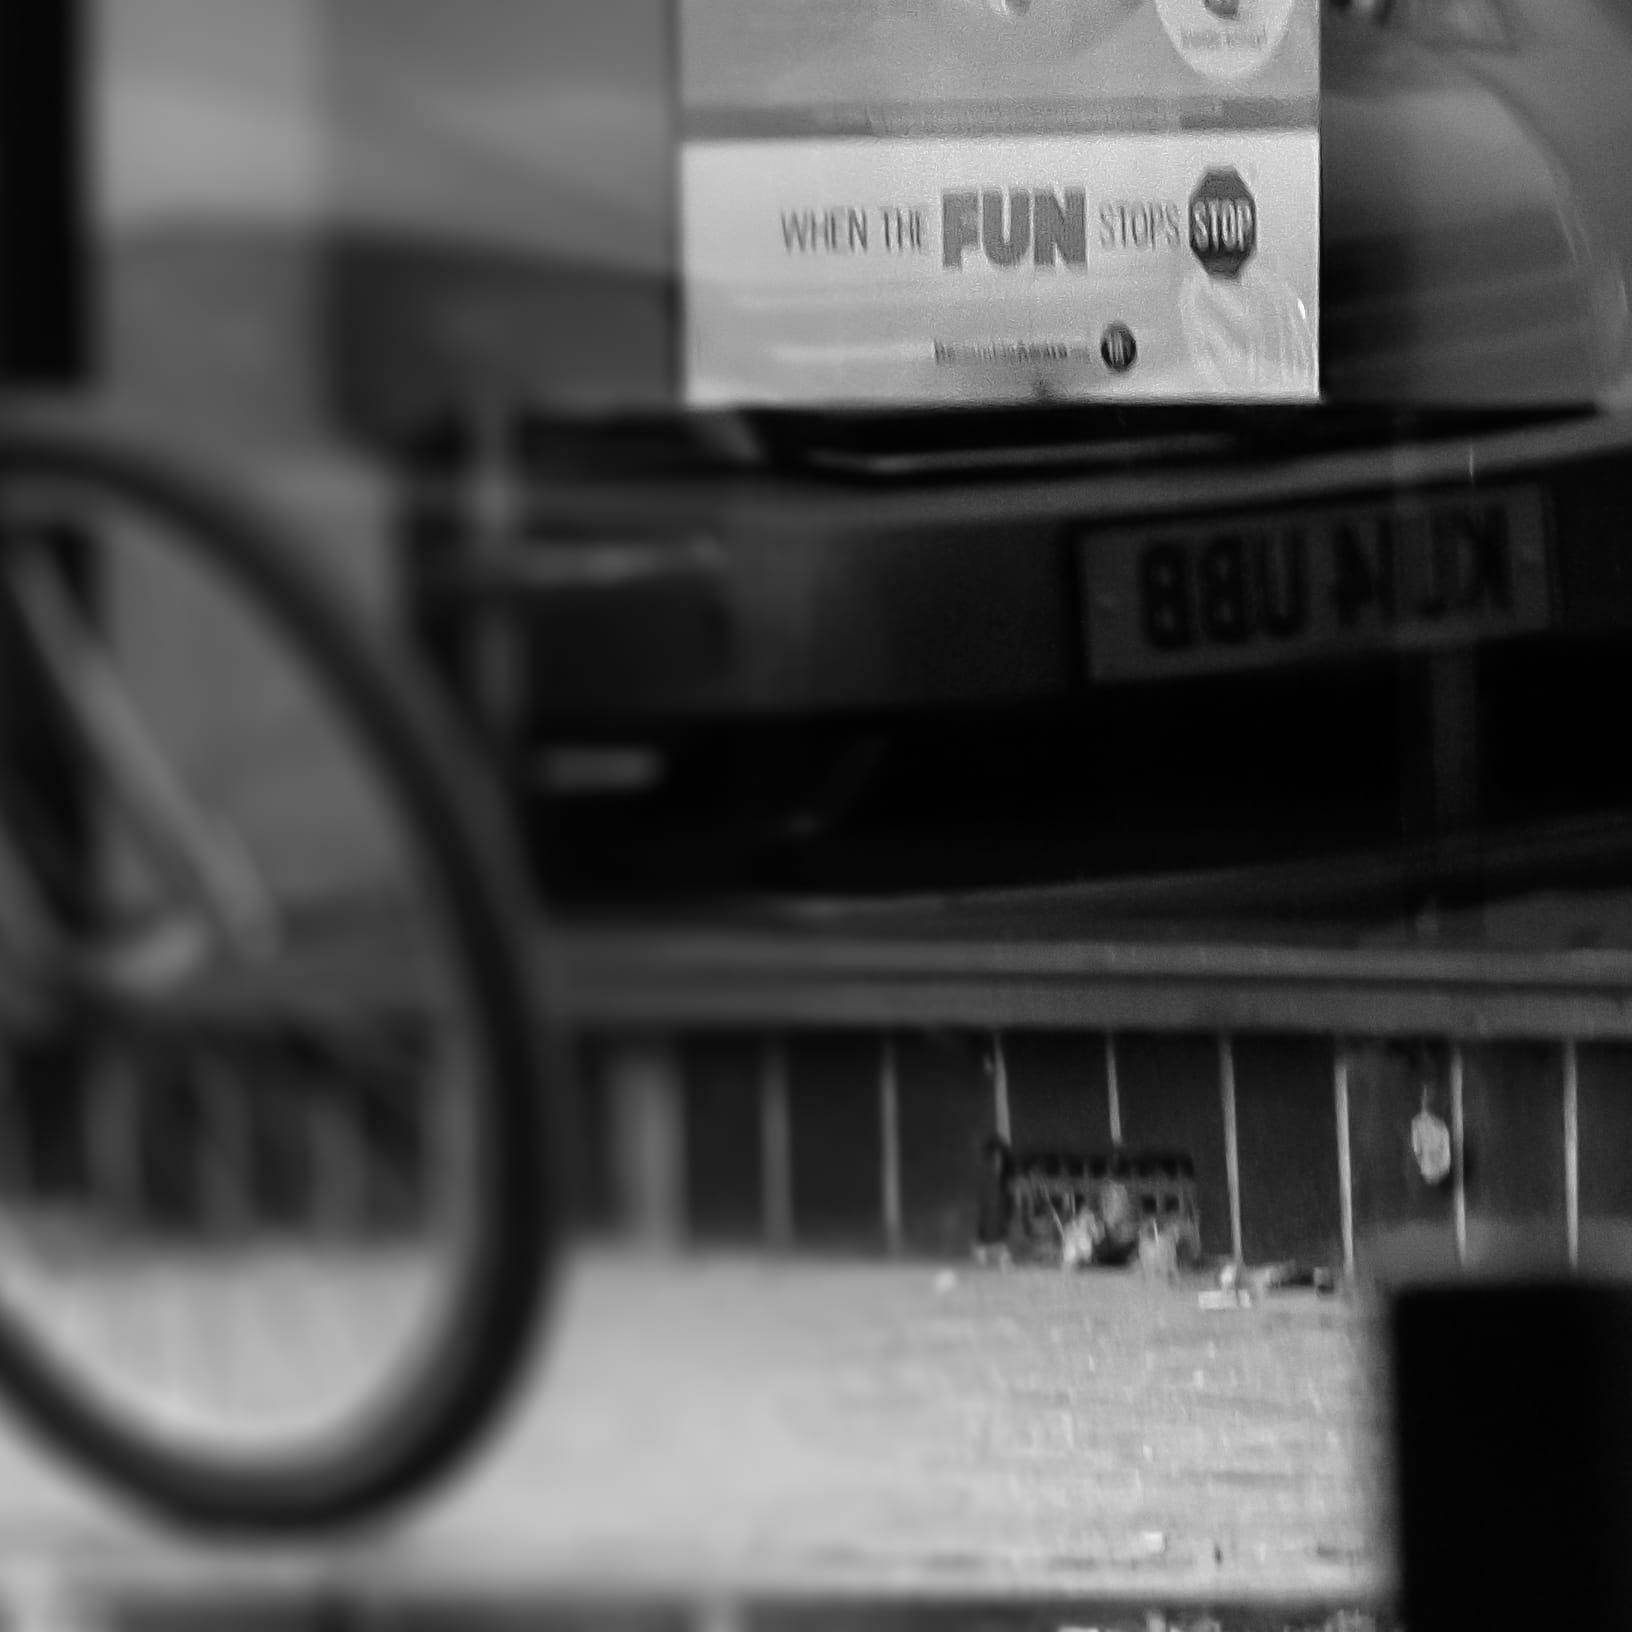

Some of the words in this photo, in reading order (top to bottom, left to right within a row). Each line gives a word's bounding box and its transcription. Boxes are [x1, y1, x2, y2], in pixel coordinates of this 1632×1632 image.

[779, 205, 868, 255] WHEN
[881, 204, 928, 254] THE
[941, 185, 1087, 272] FUN
[1099, 199, 1181, 251] STOPS
[1189, 197, 1255, 252] STOP
